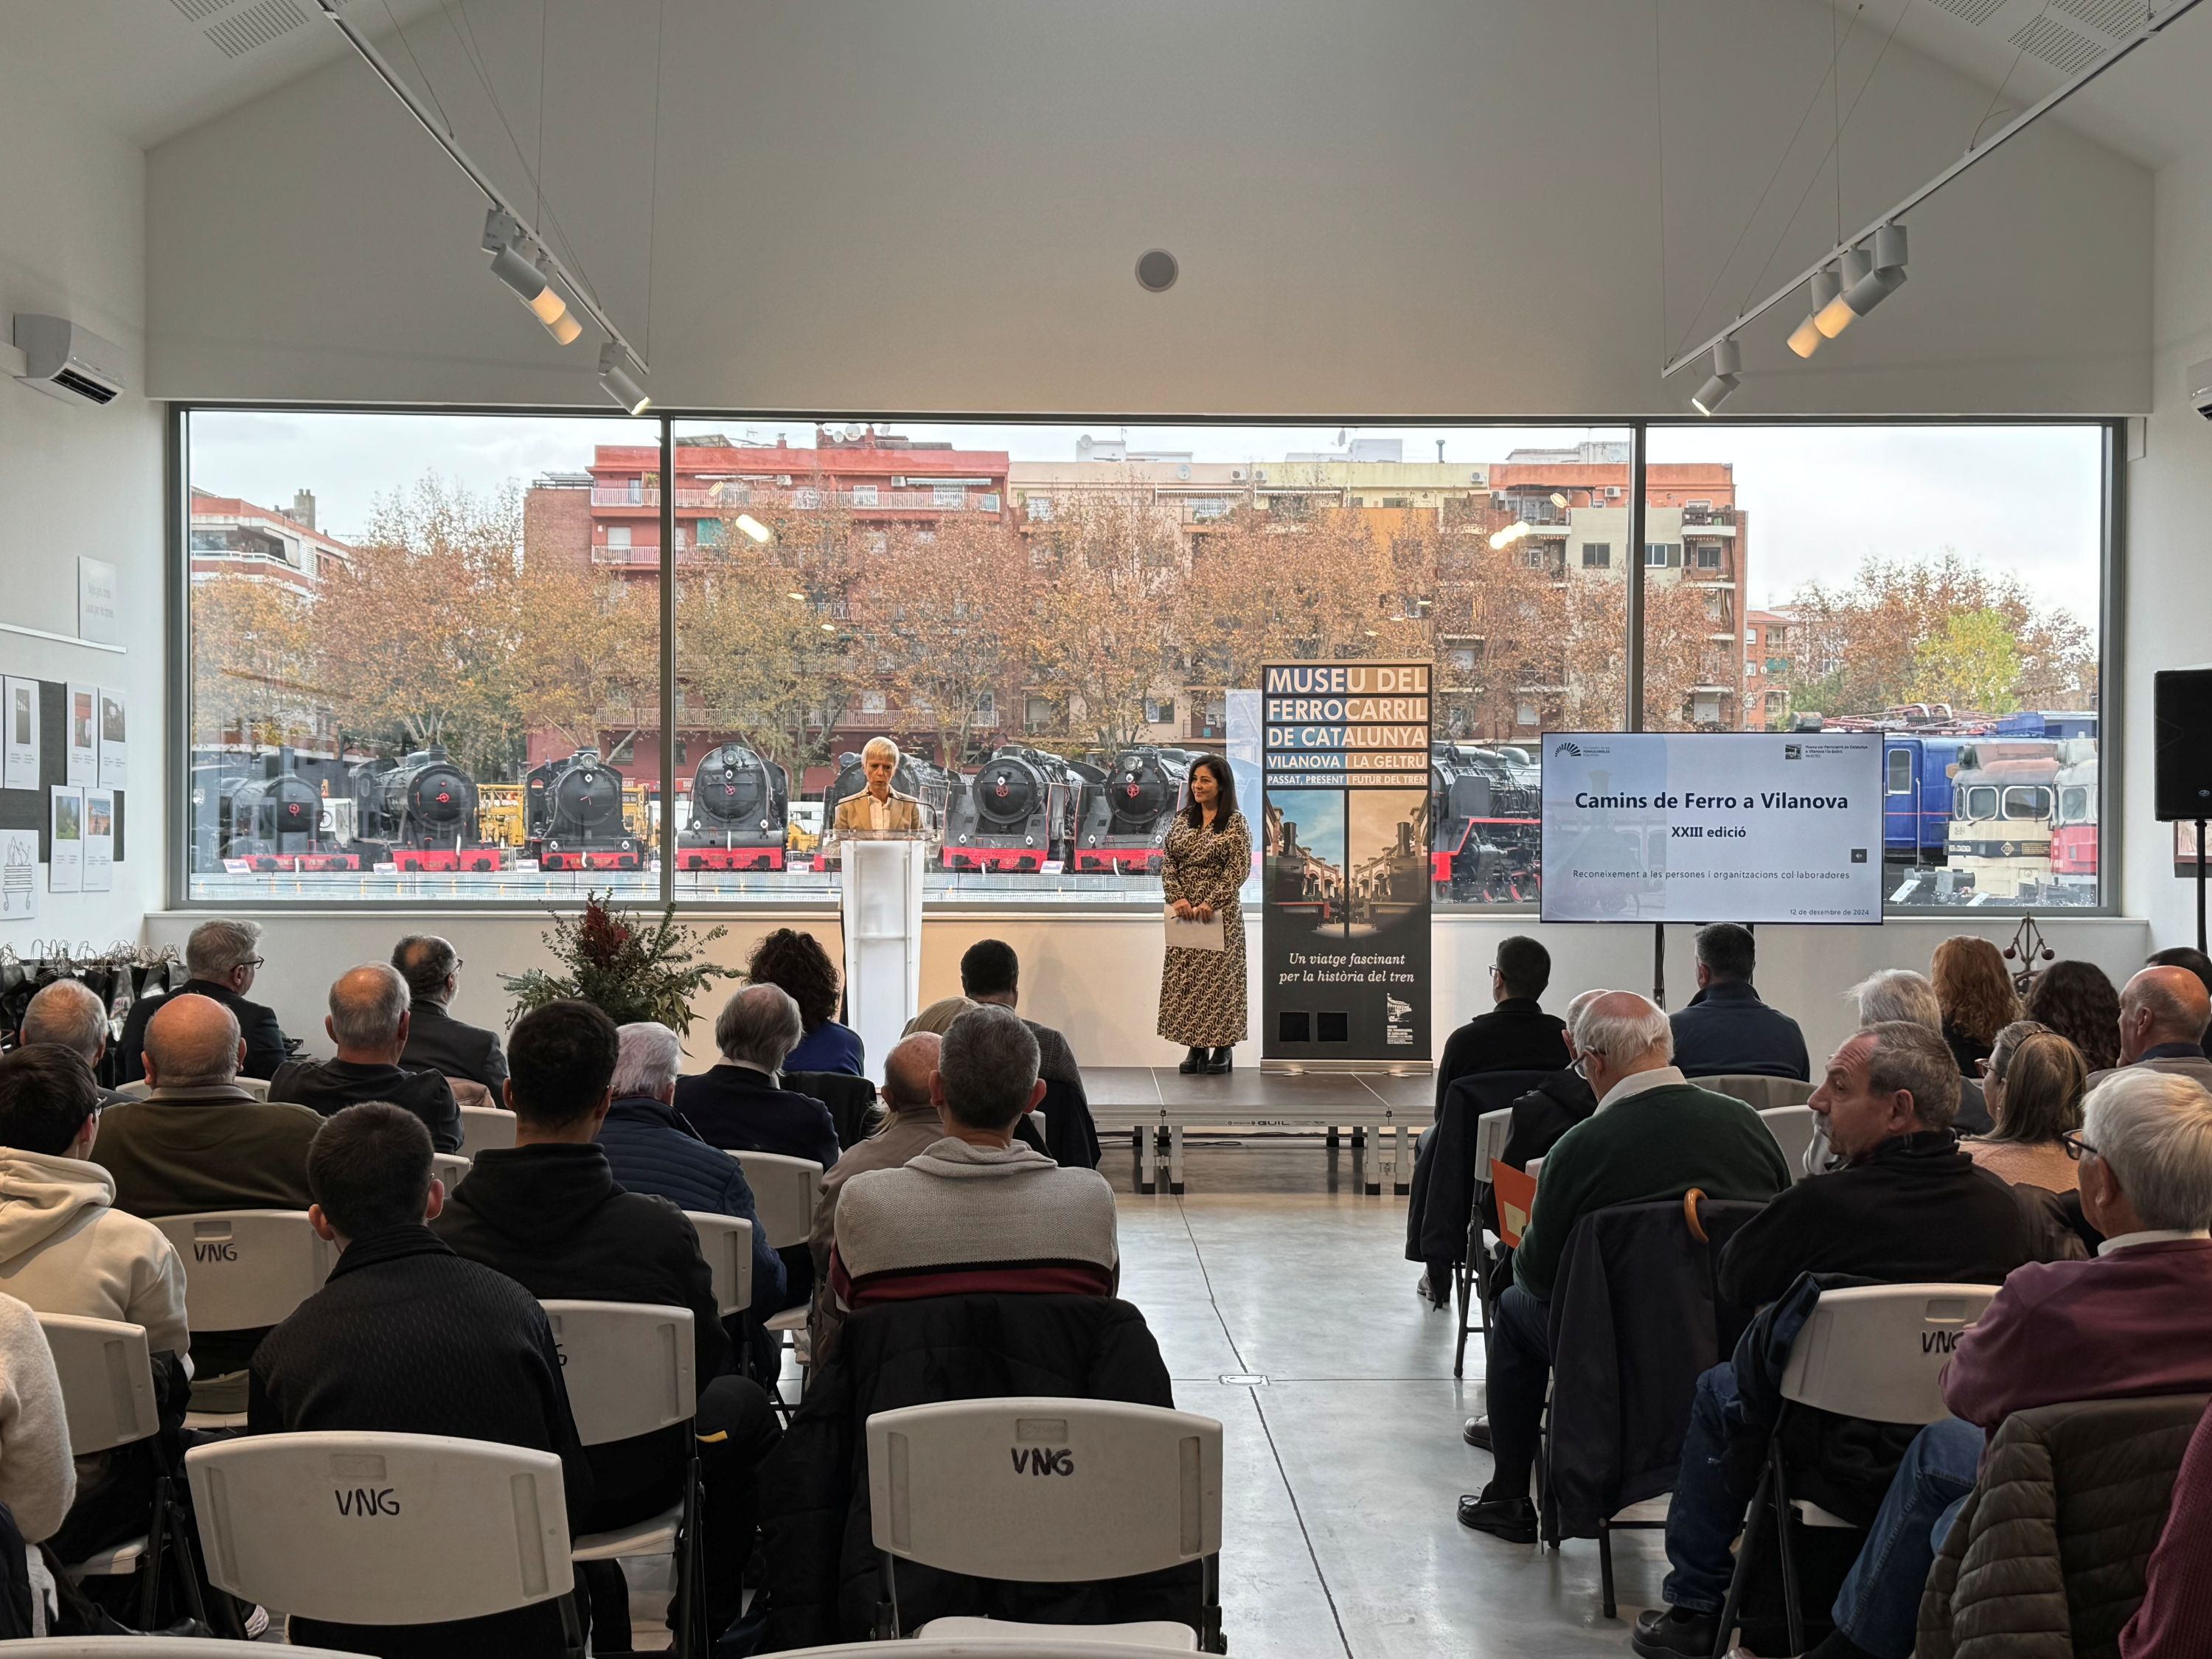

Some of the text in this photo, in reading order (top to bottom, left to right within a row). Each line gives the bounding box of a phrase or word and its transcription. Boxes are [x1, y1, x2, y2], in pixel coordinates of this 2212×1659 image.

[1267, 668, 1427, 692] MUSEU DEL
[1268, 700, 1427, 720] FERROCARRIL
[1268, 728, 1426, 746] DE CATALUNYA
[1267, 755, 1340, 768] VILANOVA
[1353, 755, 1370, 768] LA
[1374, 751, 1426, 768] GELTRÚ
[1267, 776, 1304, 785] PASSAT,
[1306, 776, 1344, 784] PRESENT
[1352, 776, 1382, 784] FUTUR
[1384, 776, 1402, 784] DEL
[1403, 776, 1427, 784] TREN
[1575, 792, 1848, 809] Camins de Ferro a Vilanova
[1671, 826, 1747, 838] XXIII edició
[1573, 870, 1639, 878] Reconeixement
[1665, 872, 1705, 880] persones
[1713, 871, 1778, 880] organitzacions
[1289, 953, 1405, 969] Un viatge fascinant
[1279, 970, 1415, 984] per la història del tren
[193, 1242, 238, 1264] VNG
[1010, 1447, 1075, 1478] VNG
[335, 1488, 401, 1517] VNG
